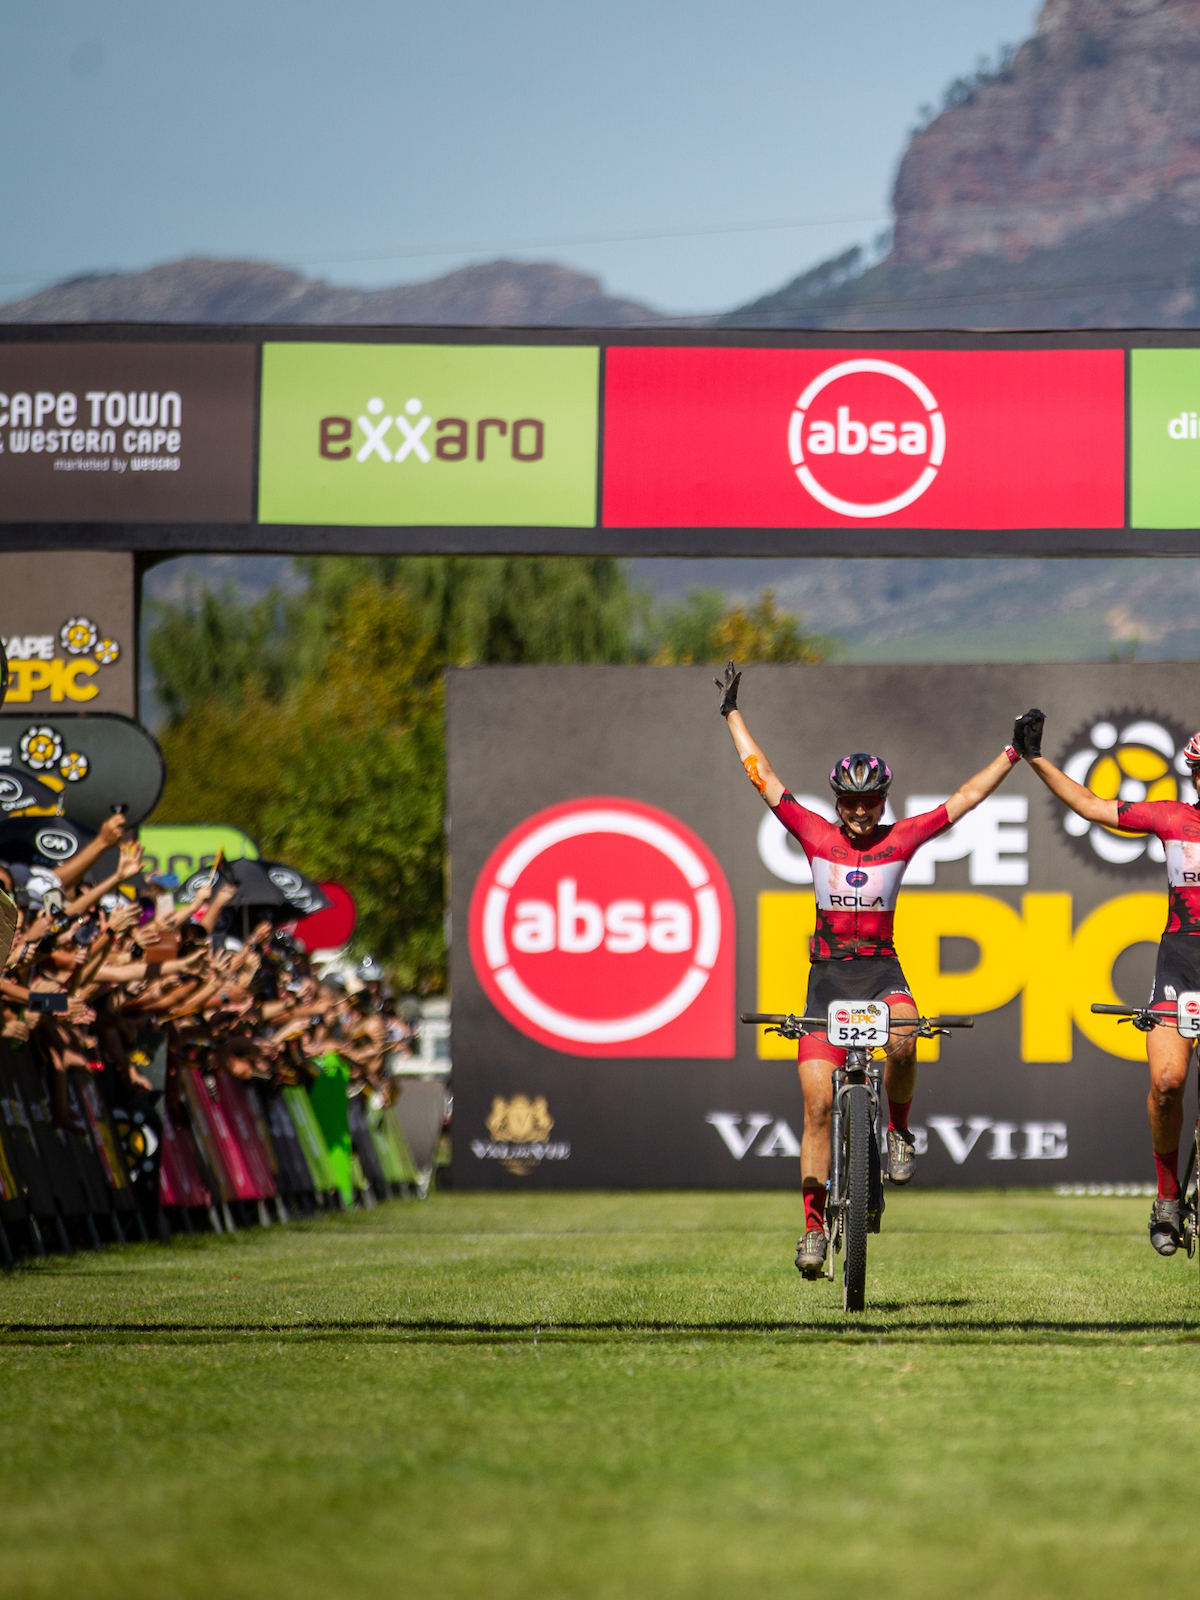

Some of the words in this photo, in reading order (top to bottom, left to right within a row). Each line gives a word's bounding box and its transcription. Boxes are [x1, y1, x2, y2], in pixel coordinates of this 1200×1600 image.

[318, 398, 545, 463] exxaro
[806, 406, 928, 456] absa
[2, 635, 54, 660] APE
[757, 795, 1028, 886] CPE
[511, 877, 693, 954] absa
[829, 895, 885, 907] ROLA
[839, 1027, 877, 1040] 52-2
[851, 1014, 876, 1024] EPIC
[705, 1112, 801, 1161] VA
[926, 1113, 1068, 1165] VIE
